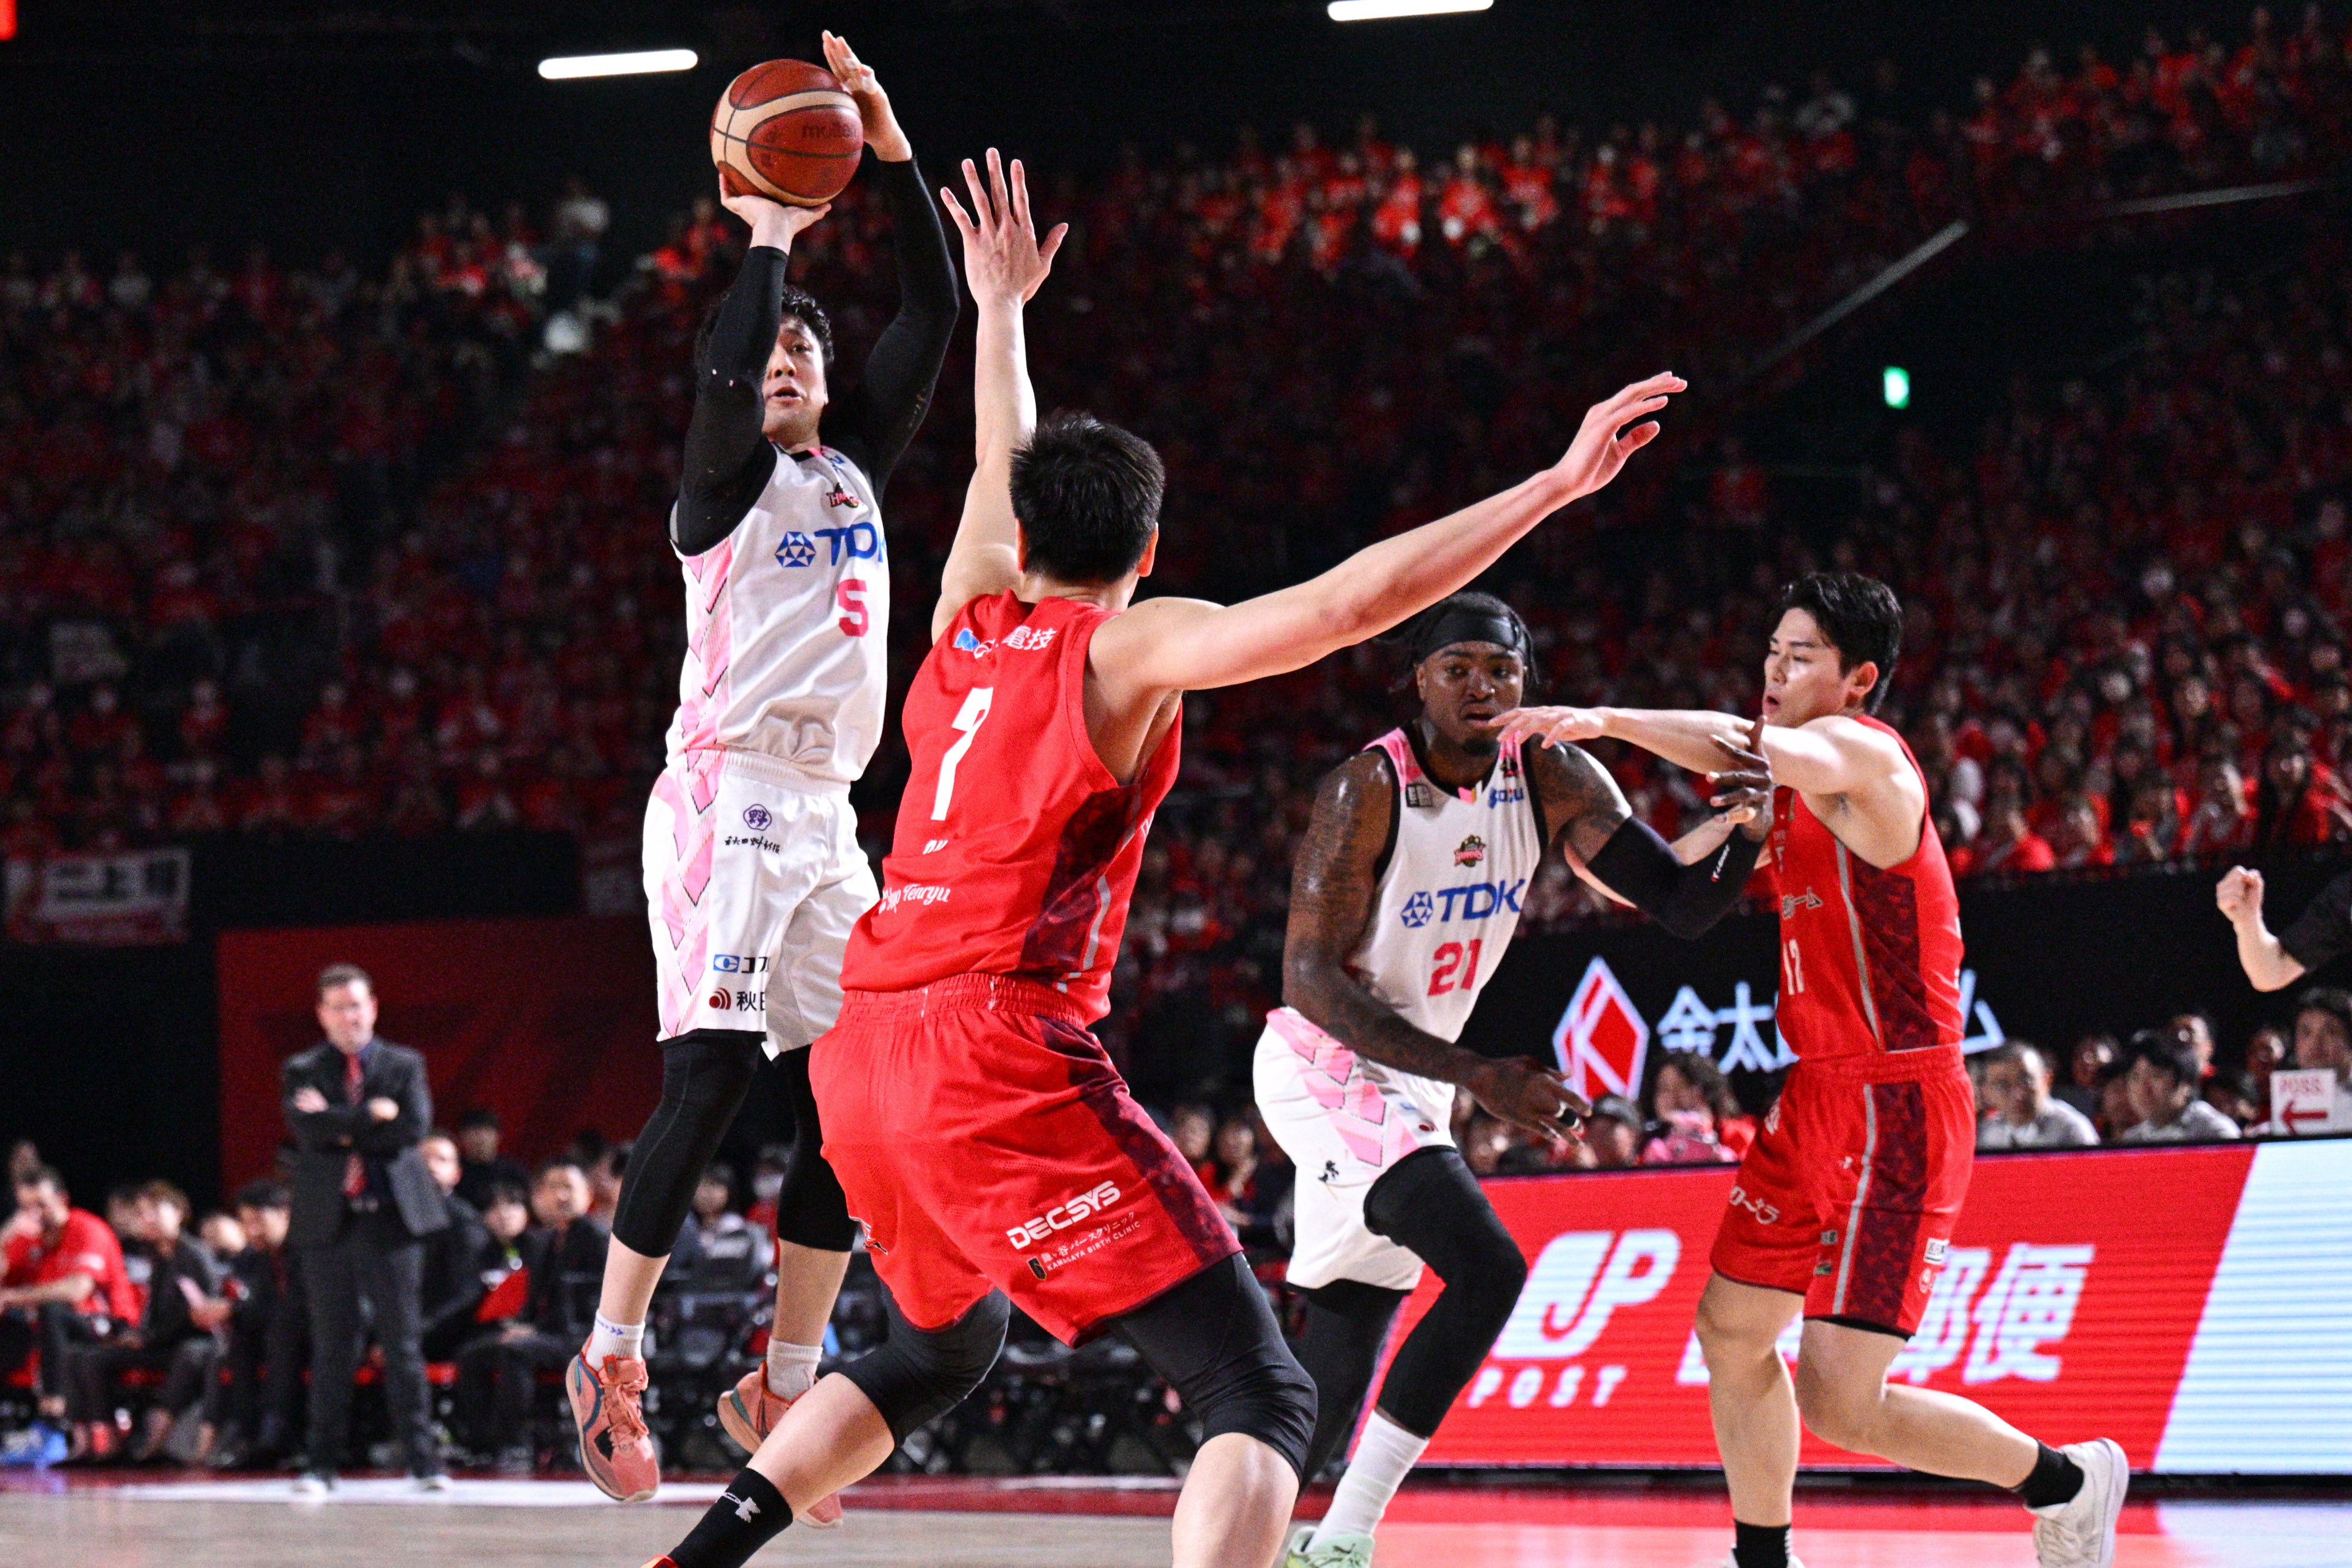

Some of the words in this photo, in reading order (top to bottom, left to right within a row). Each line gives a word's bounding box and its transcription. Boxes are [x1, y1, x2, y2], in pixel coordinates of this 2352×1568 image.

[837, 579, 868, 637] 5
[1436, 880, 1526, 922] TDK
[1428, 939, 1484, 997] 21
[1006, 1180, 1121, 1250] DECSYS
[1087, 1238, 1111, 1253] BIRTH
[1113, 1221, 1141, 1240] CLINIC
[1468, 1365, 1626, 1407] POST
